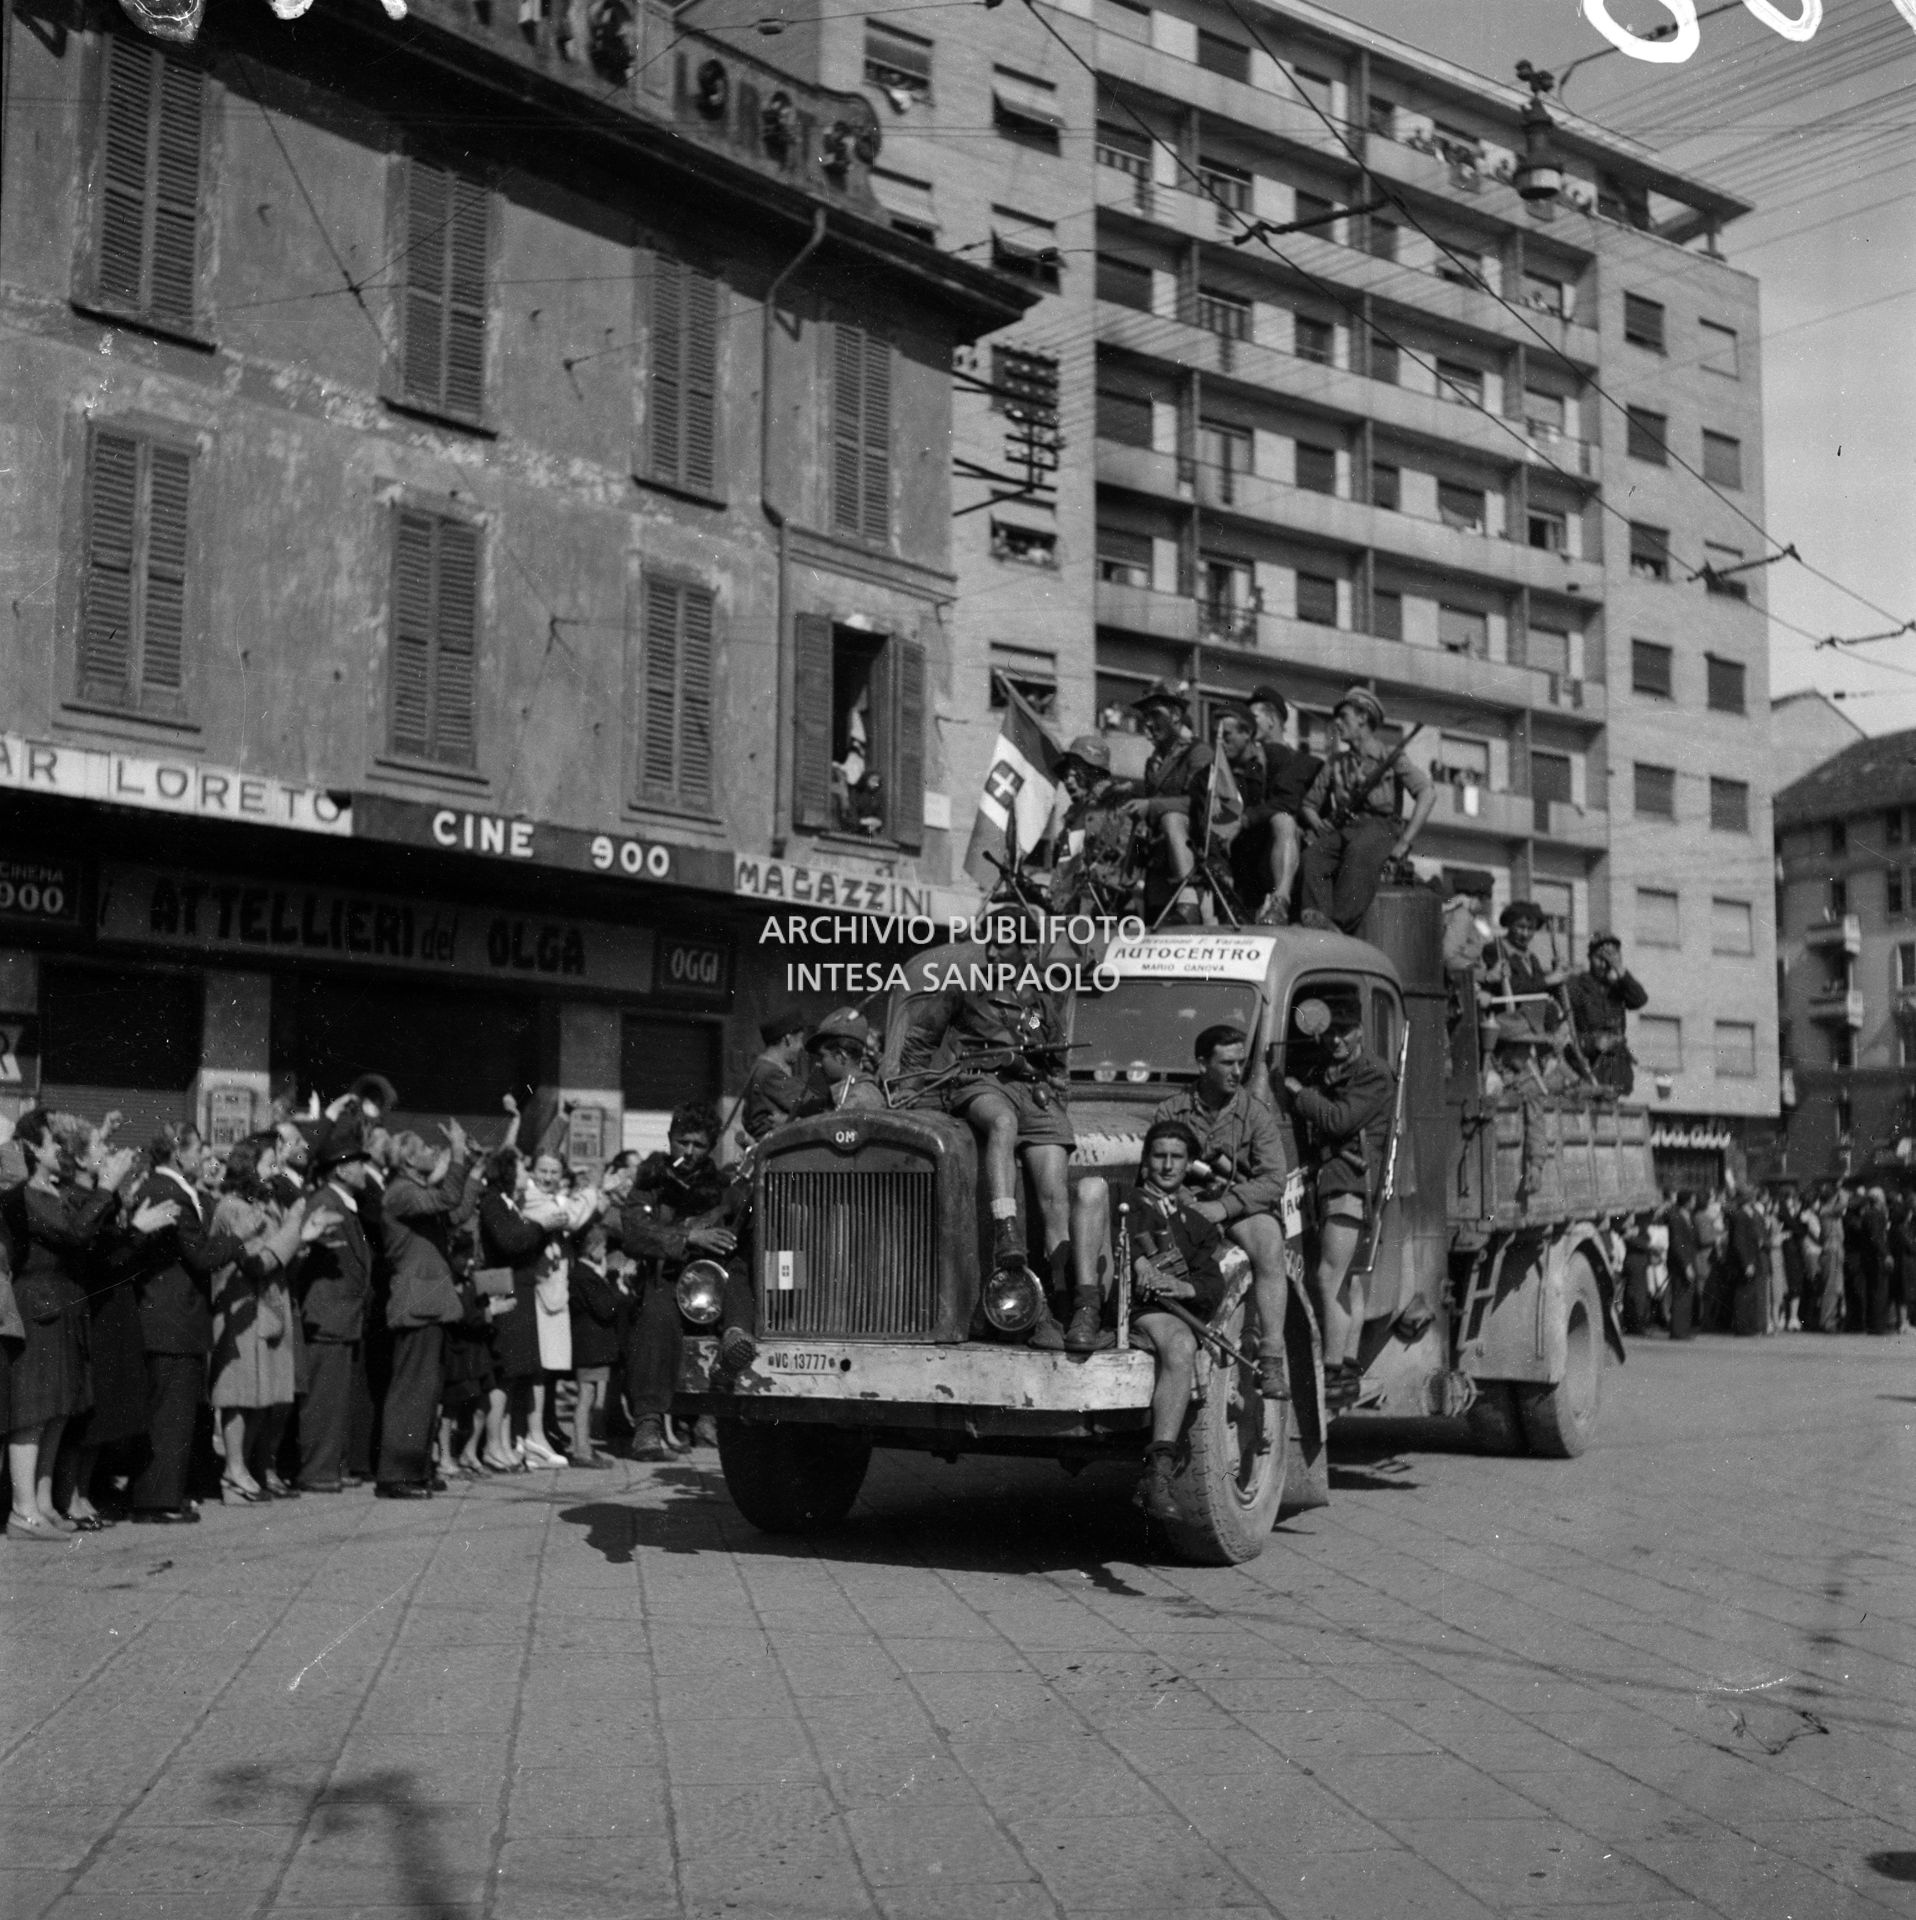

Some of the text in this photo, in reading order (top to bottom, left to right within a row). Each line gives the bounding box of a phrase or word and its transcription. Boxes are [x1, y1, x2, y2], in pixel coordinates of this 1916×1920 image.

[116, 760, 342, 823] LORETO
[432, 811, 670, 878] CINE 900
[0, 880, 64, 915] 900
[737, 861, 931, 918] MAGAZZINI
[149, 877, 414, 958] ATTELLIERI
[488, 917, 586, 976] OLGA
[671, 946, 719, 984] OGGI
[1114, 947, 1261, 961] AUTOCENTRO
[1141, 963, 1175, 972] MARIO
[835, 1130, 856, 1144] OM
[775, 1352, 827, 1370] VC 13777
